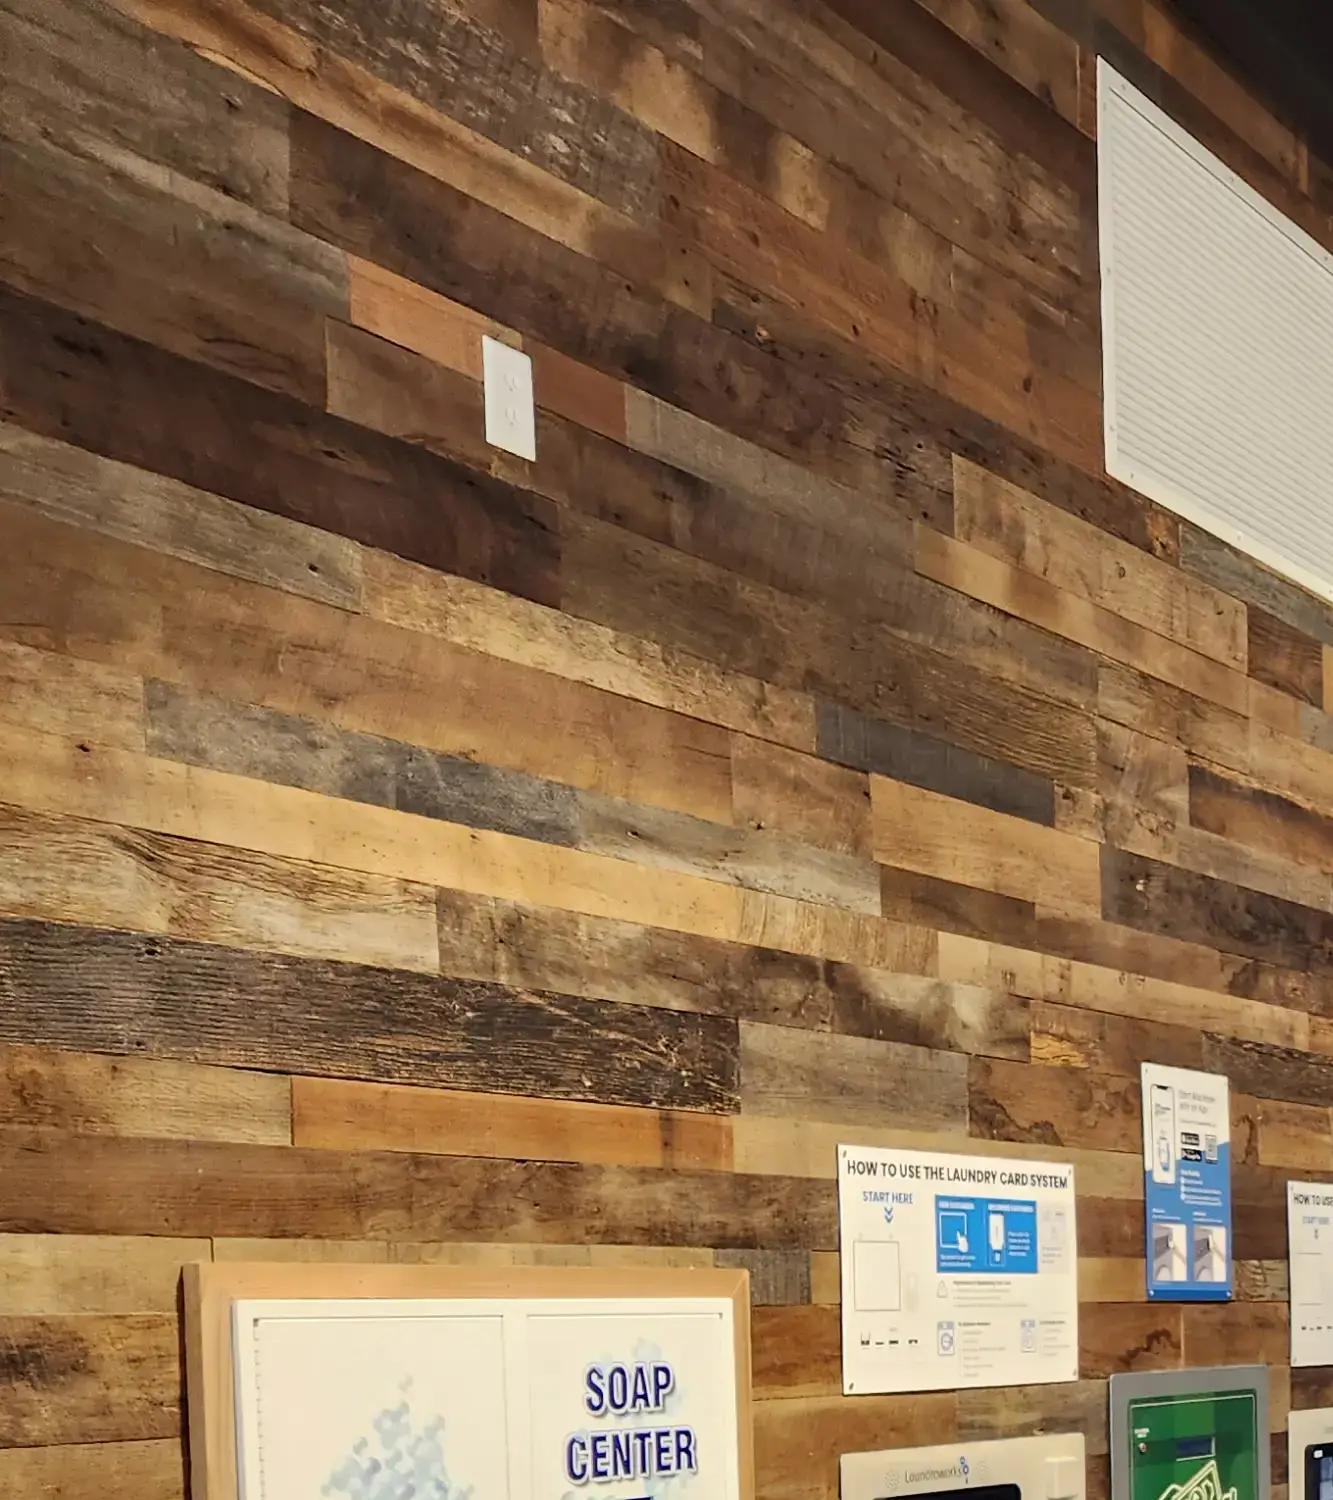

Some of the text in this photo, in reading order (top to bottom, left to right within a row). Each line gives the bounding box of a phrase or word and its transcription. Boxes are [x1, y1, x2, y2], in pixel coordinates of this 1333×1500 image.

[847, 1160, 1068, 1189] HOW TO USE THE LAUNDRY CARD SYSTEM
[862, 1191, 914, 1205] START HERE
[1293, 1193, 1309, 1205] HOW
[1311, 1195, 1320, 1206] TO
[1321, 1196, 1333, 1207] USE
[585, 1364, 674, 1414] SOAP
[566, 1428, 698, 1483] CENTER
